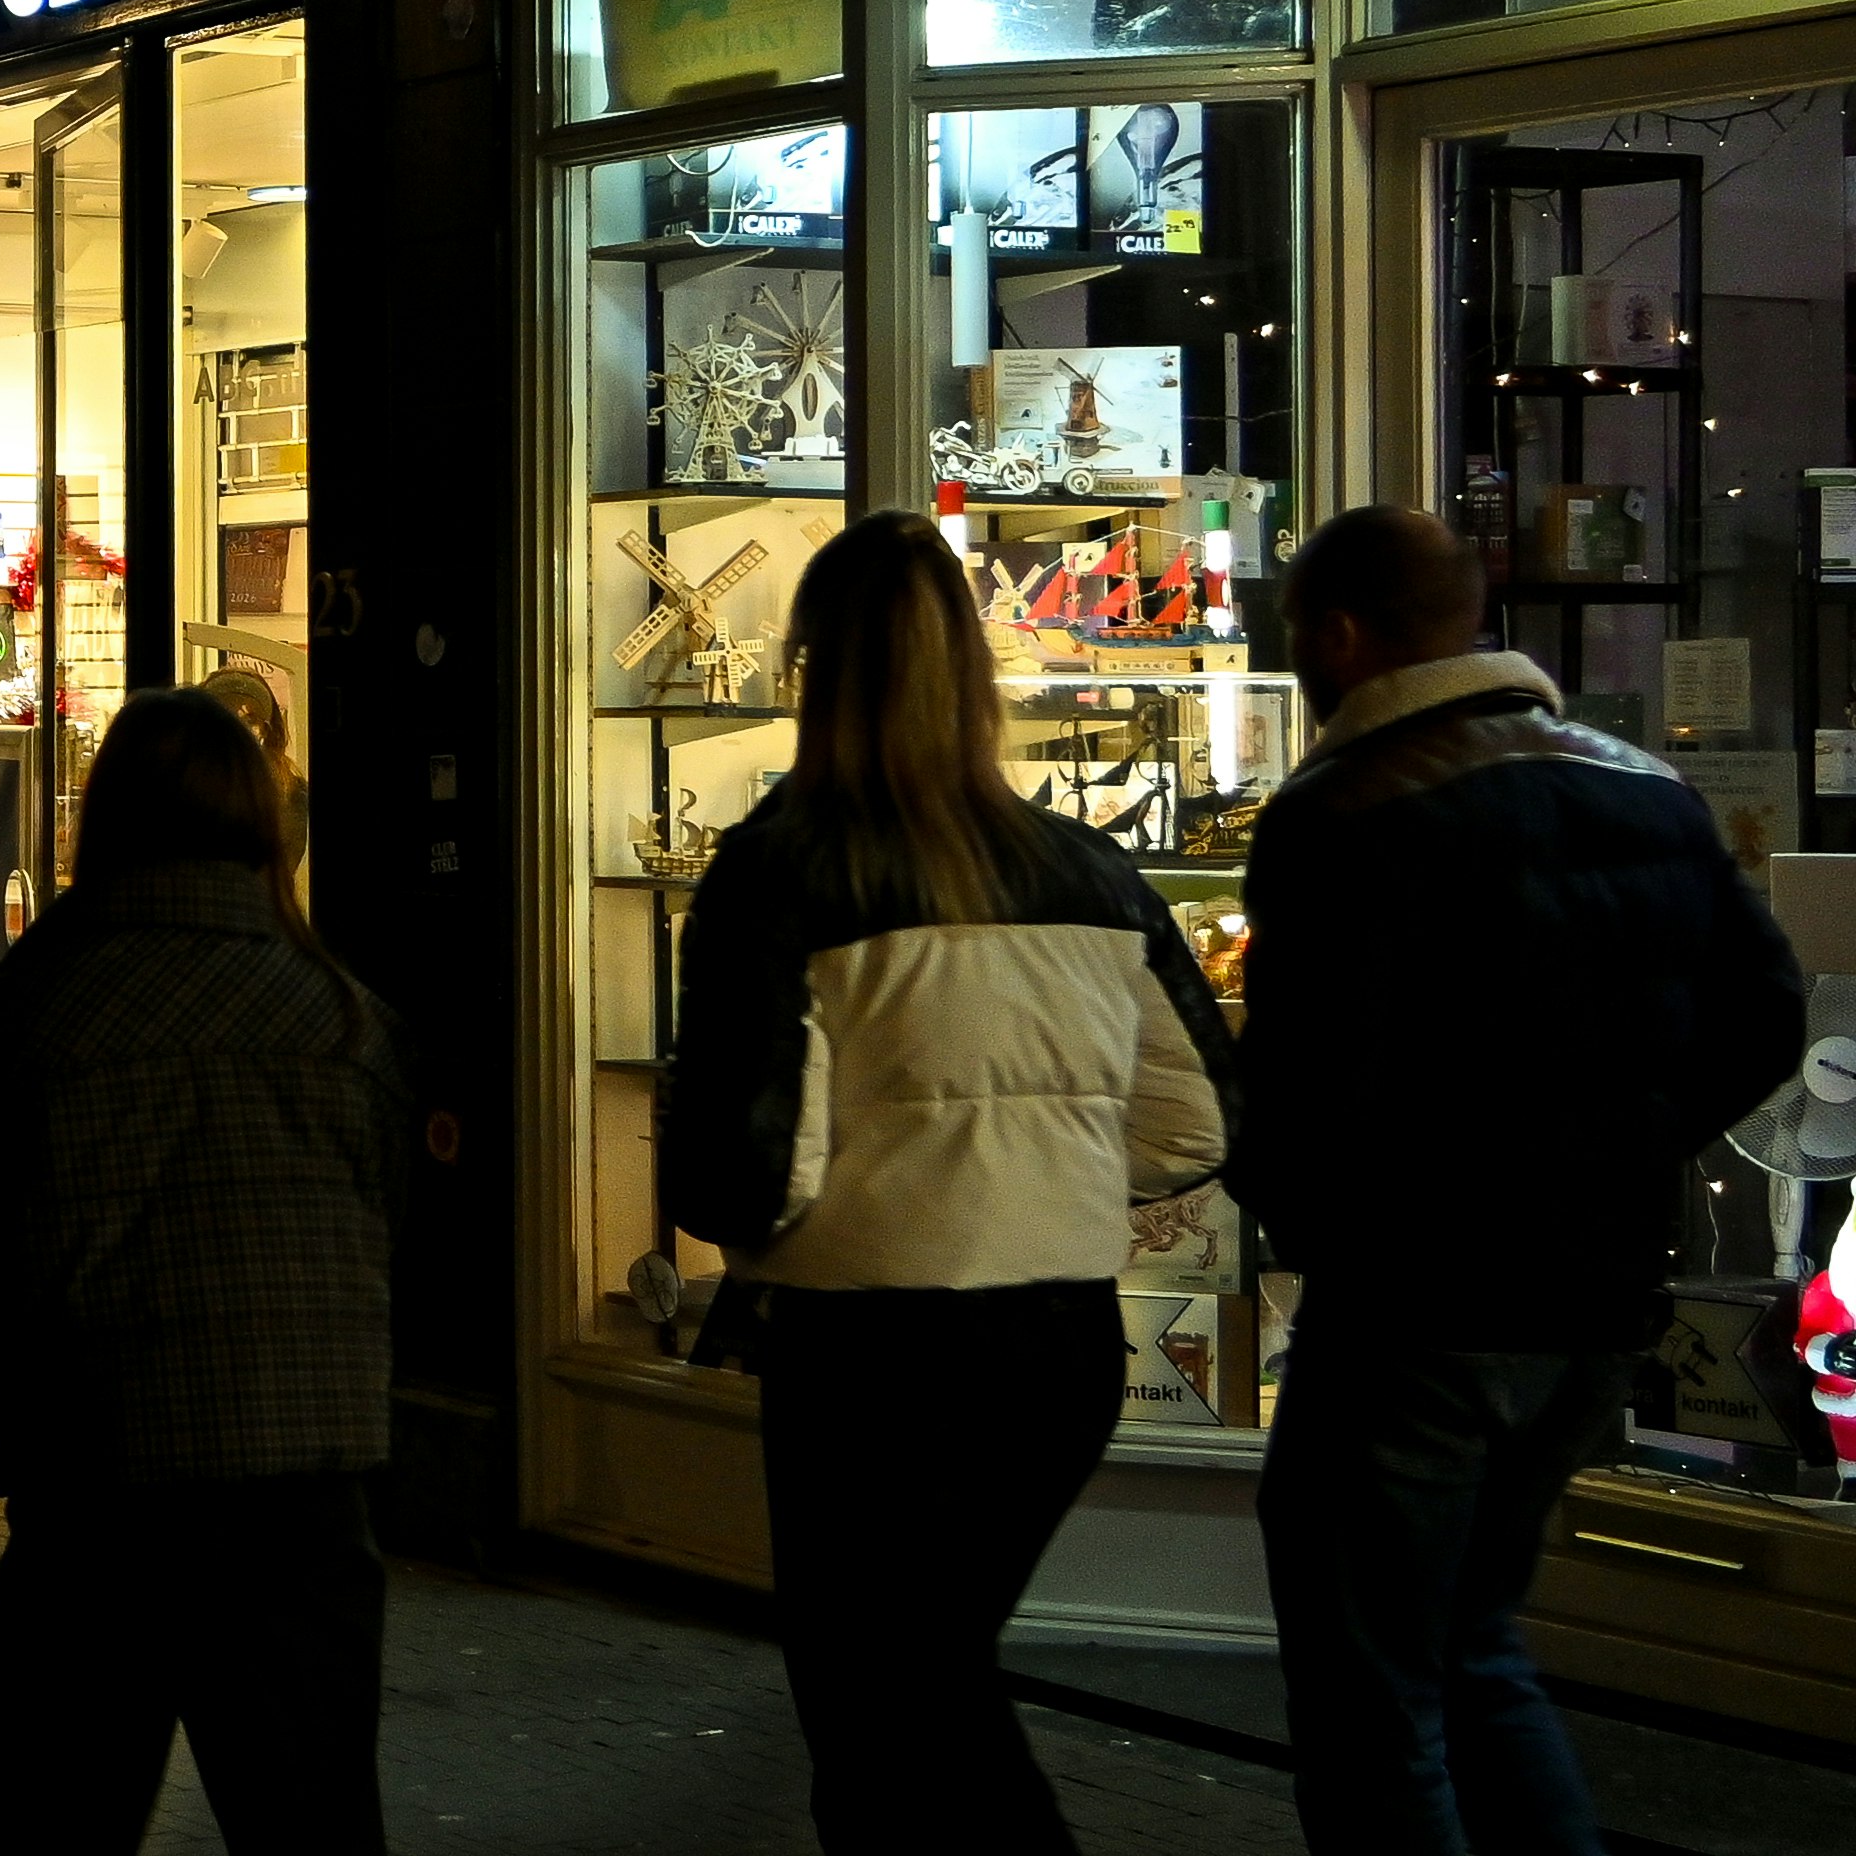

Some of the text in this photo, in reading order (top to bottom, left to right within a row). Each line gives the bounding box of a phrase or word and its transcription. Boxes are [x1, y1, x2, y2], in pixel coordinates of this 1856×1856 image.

[1120, 235, 1166, 253] CALE
[1125, 1383, 1183, 1403] ntakt
[1681, 1395, 1759, 1421] kontakt
